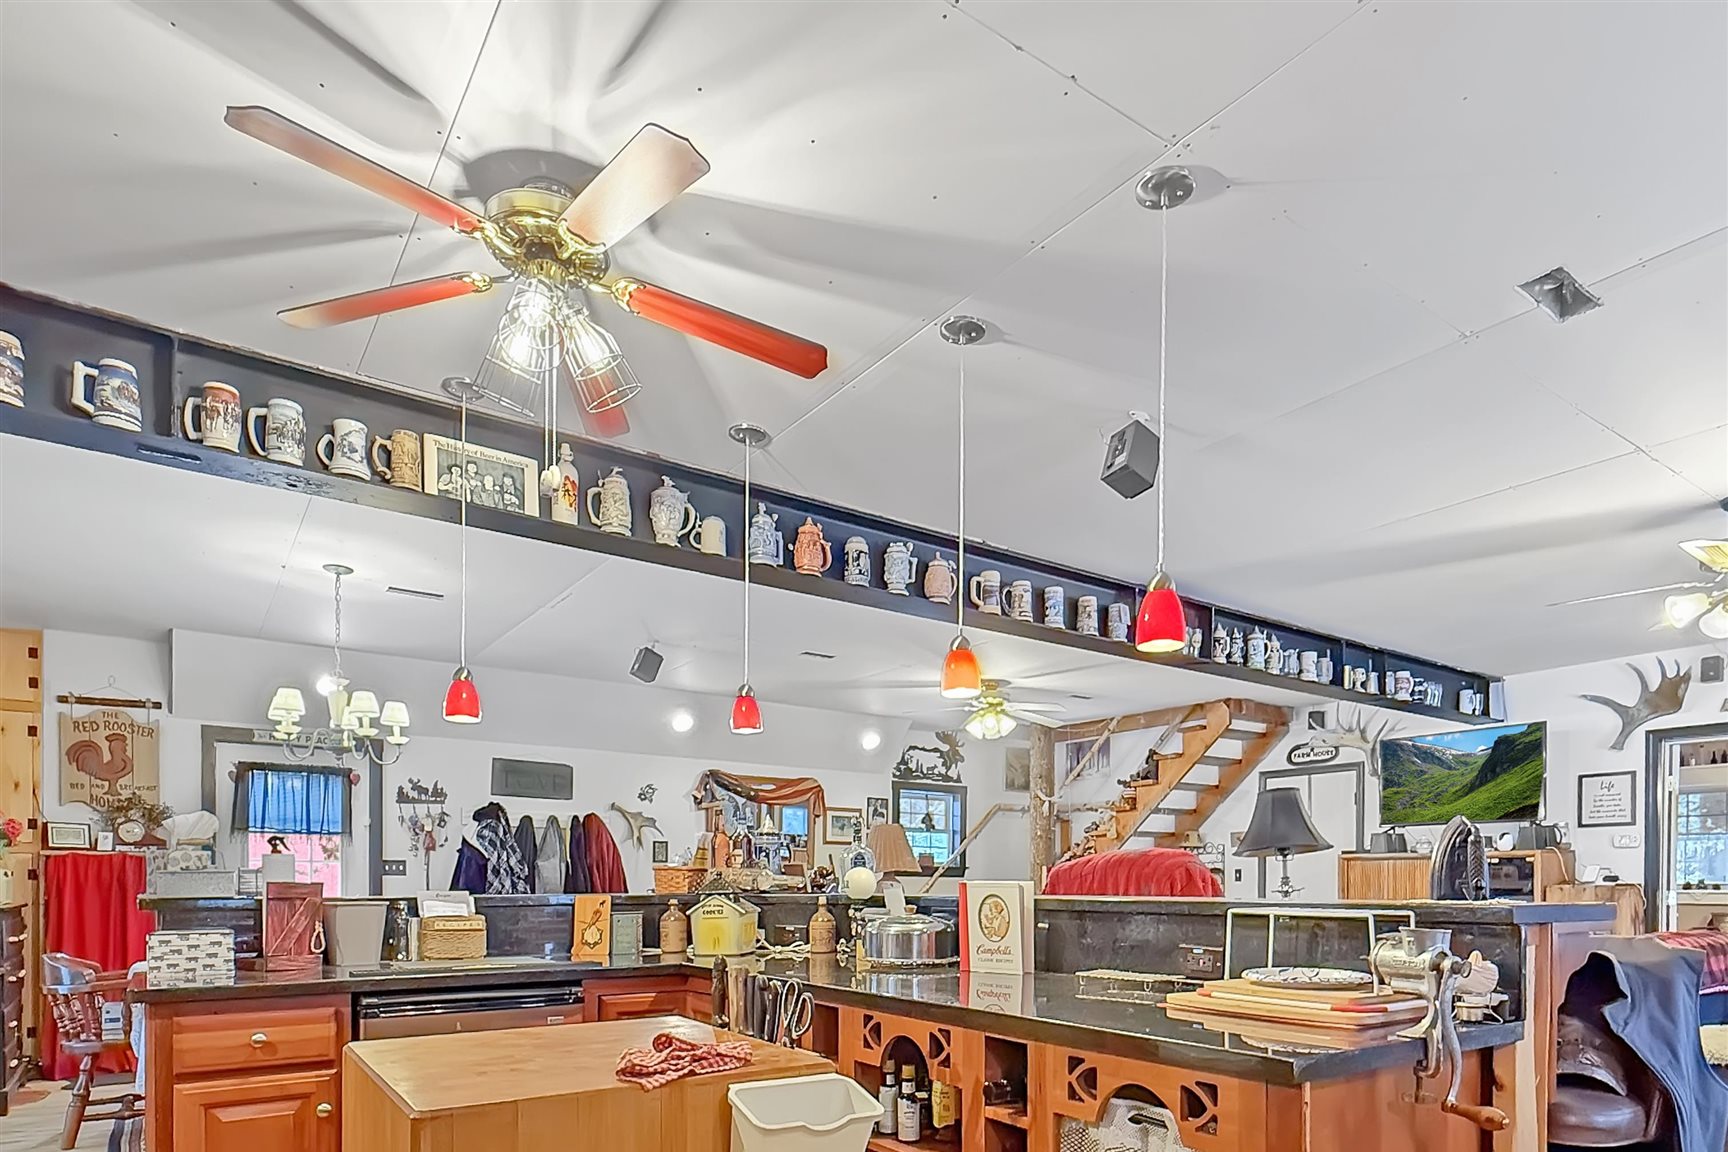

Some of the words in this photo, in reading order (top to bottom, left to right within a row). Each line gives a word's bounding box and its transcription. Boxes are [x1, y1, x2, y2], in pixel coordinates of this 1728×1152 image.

[445, 441, 471, 455] Histry
[503, 456, 529, 468] America
[102, 711, 120, 719] THE
[72, 720, 100, 734] RED
[103, 720, 155, 739] ROOSTER
[69, 782, 85, 790] BED
[1600, 780, 1615, 792] Life
[975, 943, 1013, 957] Campbell's
